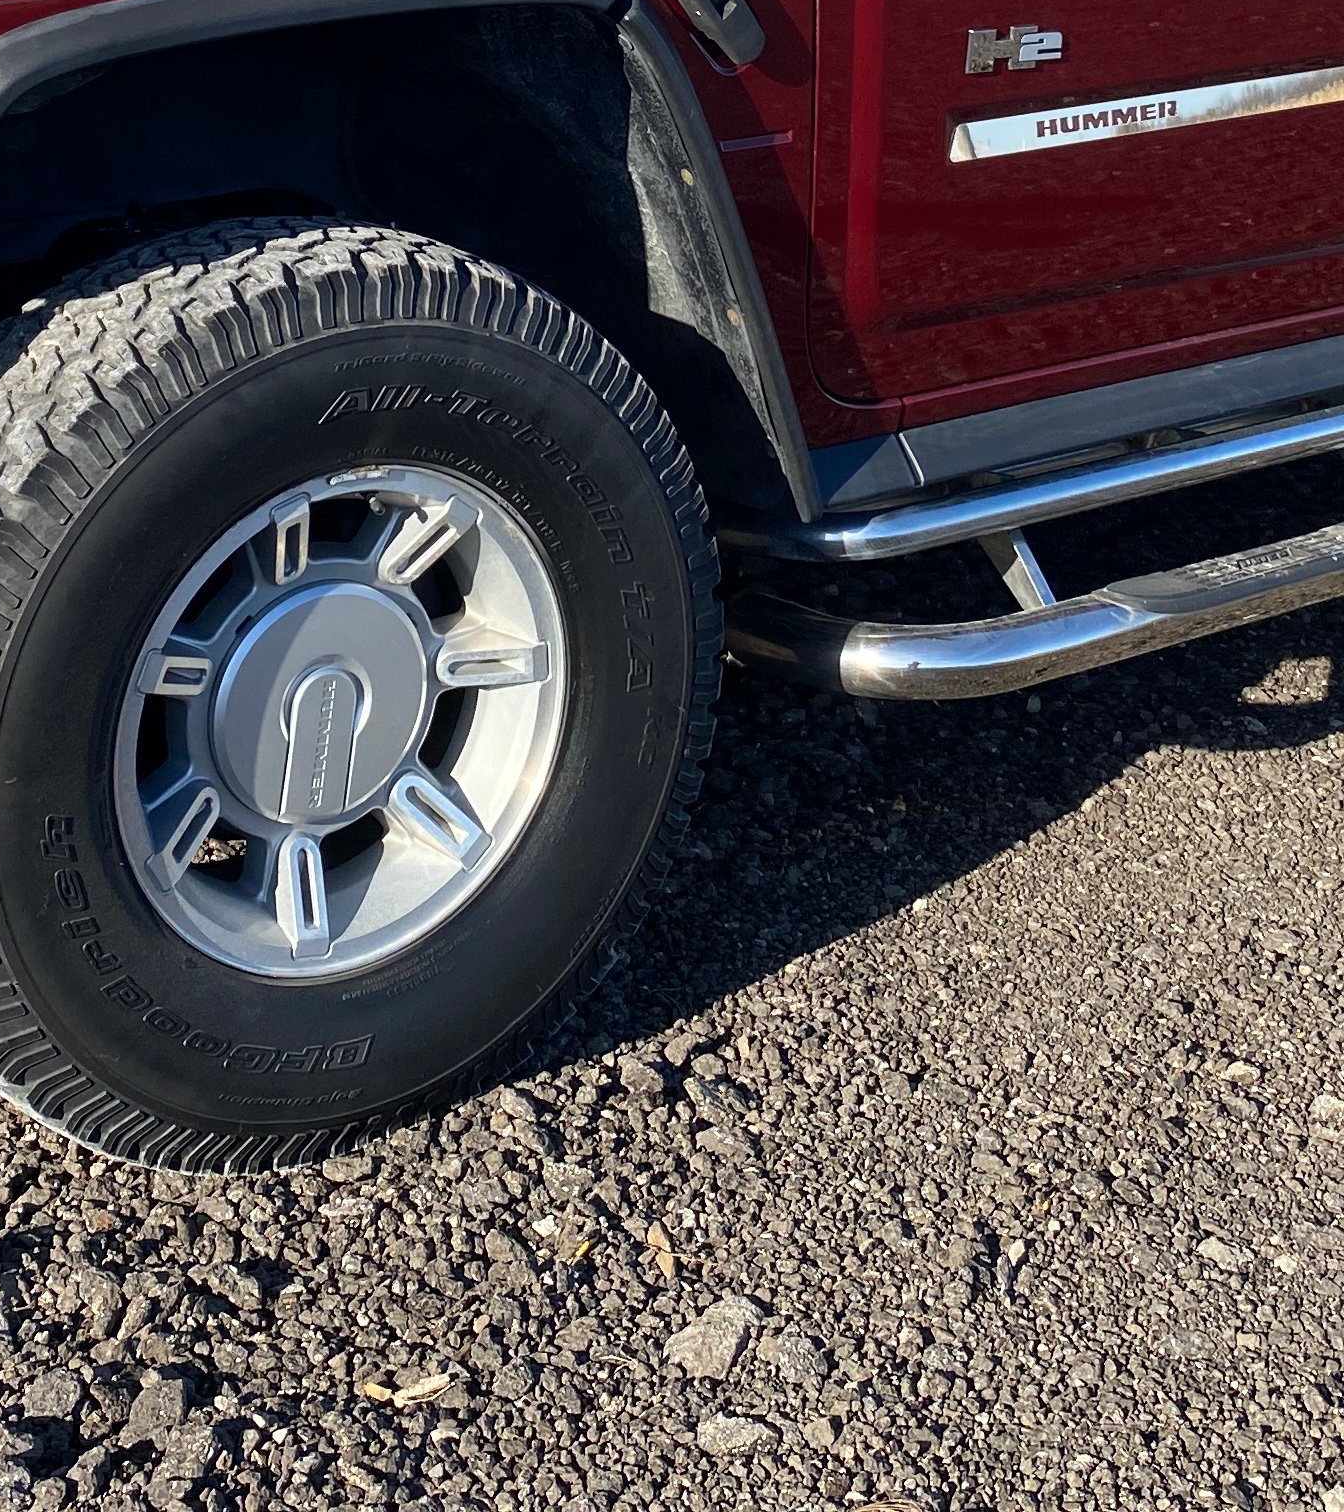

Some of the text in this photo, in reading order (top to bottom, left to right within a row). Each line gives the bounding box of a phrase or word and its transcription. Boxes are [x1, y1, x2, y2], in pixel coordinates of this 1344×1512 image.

[964, 25, 1063, 74] H2
[1035, 100, 1178, 138] HUMMER
[318, 383, 634, 566] All-Terrain
[307, 680, 337, 809] HUMMER
[39, 813, 375, 1074] BFGoodrich
